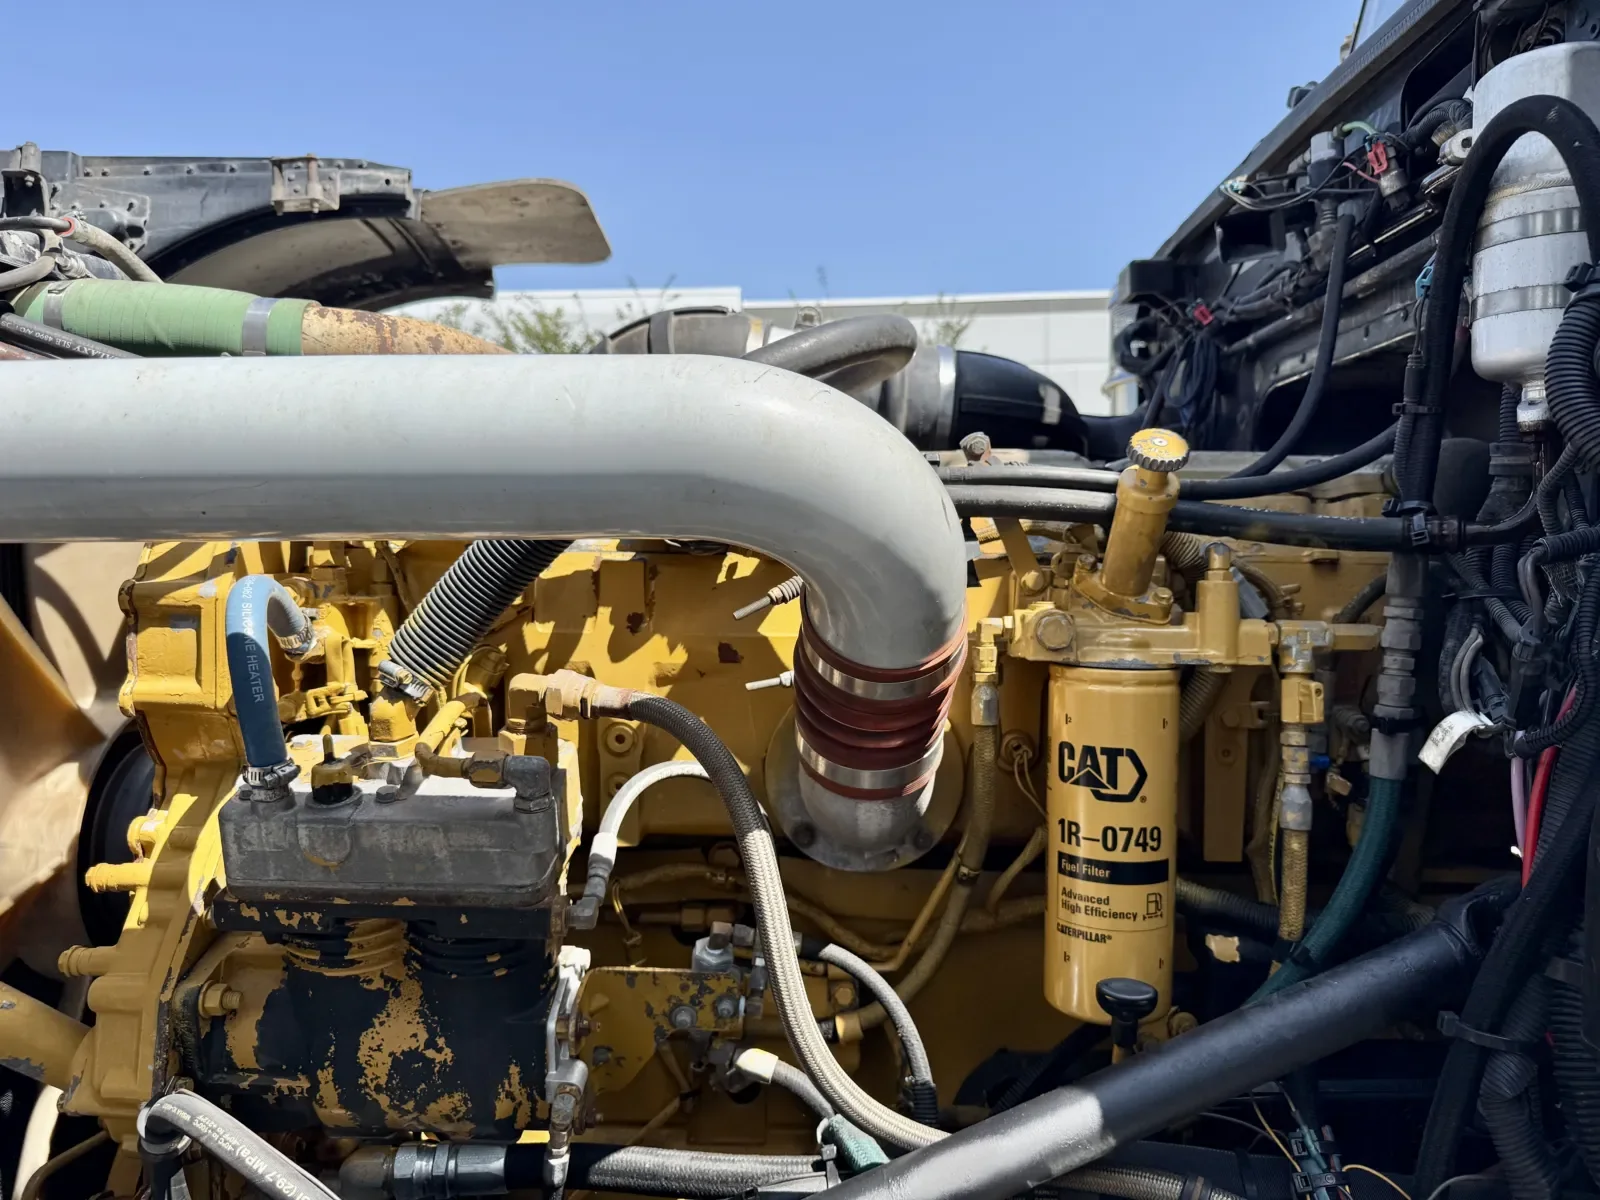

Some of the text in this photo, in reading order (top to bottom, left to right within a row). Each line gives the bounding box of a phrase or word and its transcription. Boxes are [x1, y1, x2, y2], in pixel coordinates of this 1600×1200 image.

[56, 338, 72, 349] SLE
[74, 344, 117, 359] ALAXY
[241, 602, 257, 652] SILICONE
[246, 654, 265, 704] HEATER
[1058, 741, 1125, 790] CAT
[1058, 817, 1162, 853] 1R-0749
[1061, 858, 1111, 878] Fuel Filter
[1061, 886, 1110, 906] Advanced
[1061, 898, 1138, 922] High Efficiency
[235, 1144, 269, 1175] MPa)
